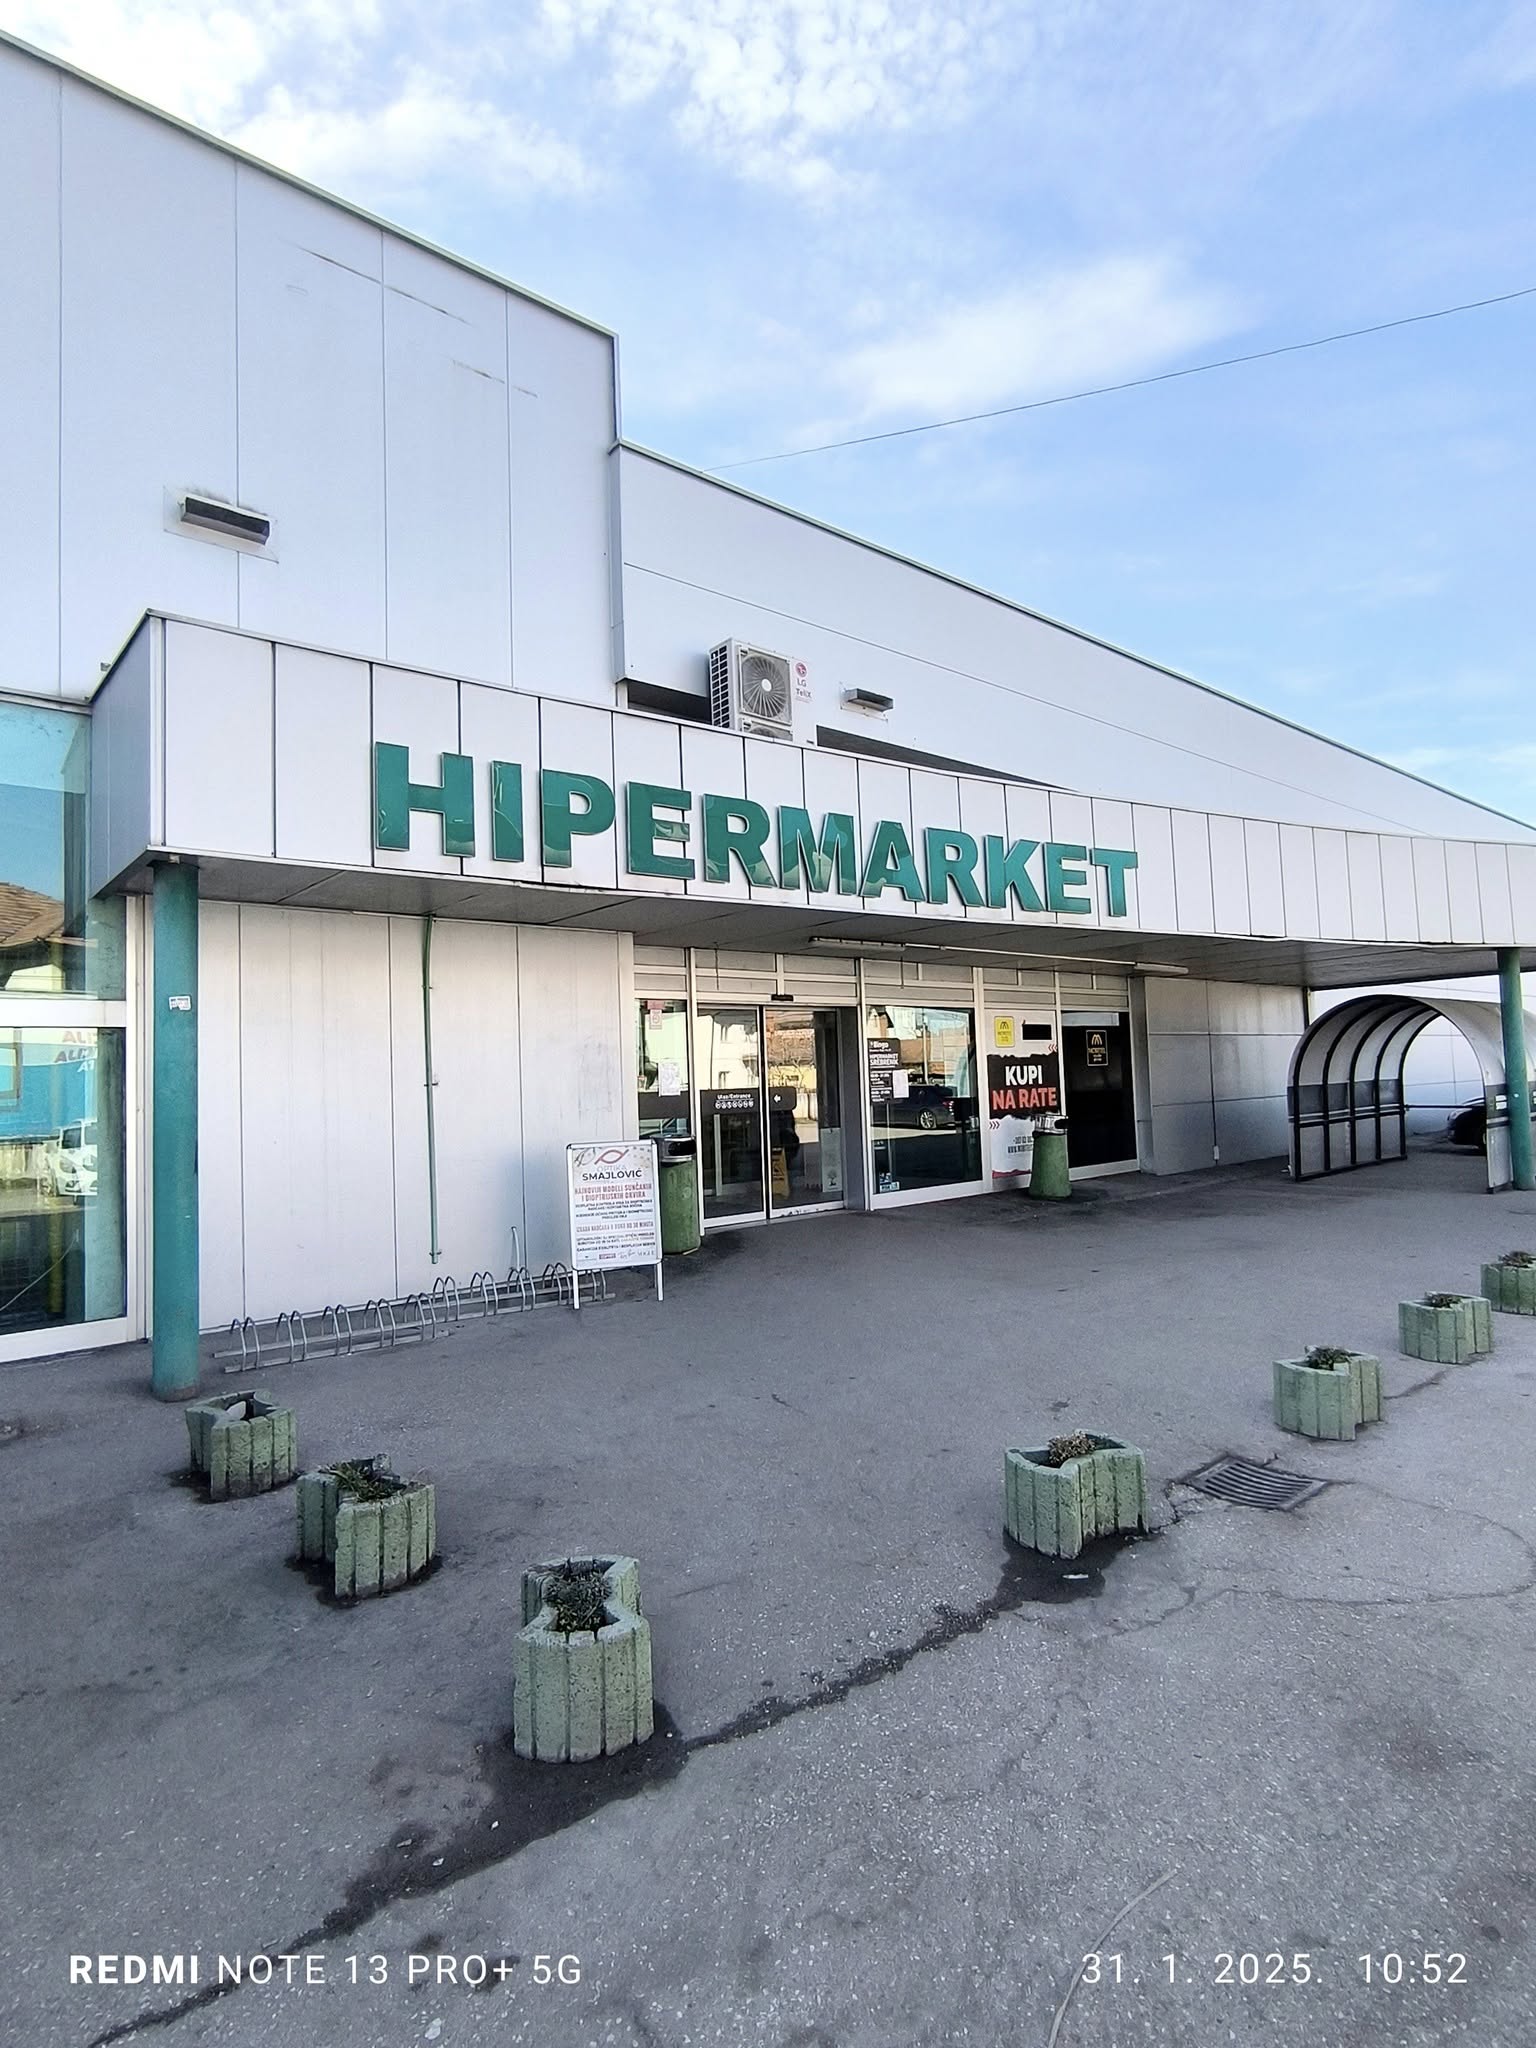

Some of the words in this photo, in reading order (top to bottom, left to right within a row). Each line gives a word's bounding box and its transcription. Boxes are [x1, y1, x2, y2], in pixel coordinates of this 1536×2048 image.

[375, 742, 1138, 916] HIPERMARKET
[1005, 1065, 1043, 1087] KUPI
[992, 1089, 1017, 1110] NA
[1018, 1087, 1058, 1108] RATE
[582, 1168, 643, 1181] SMAJLOVIĆ
